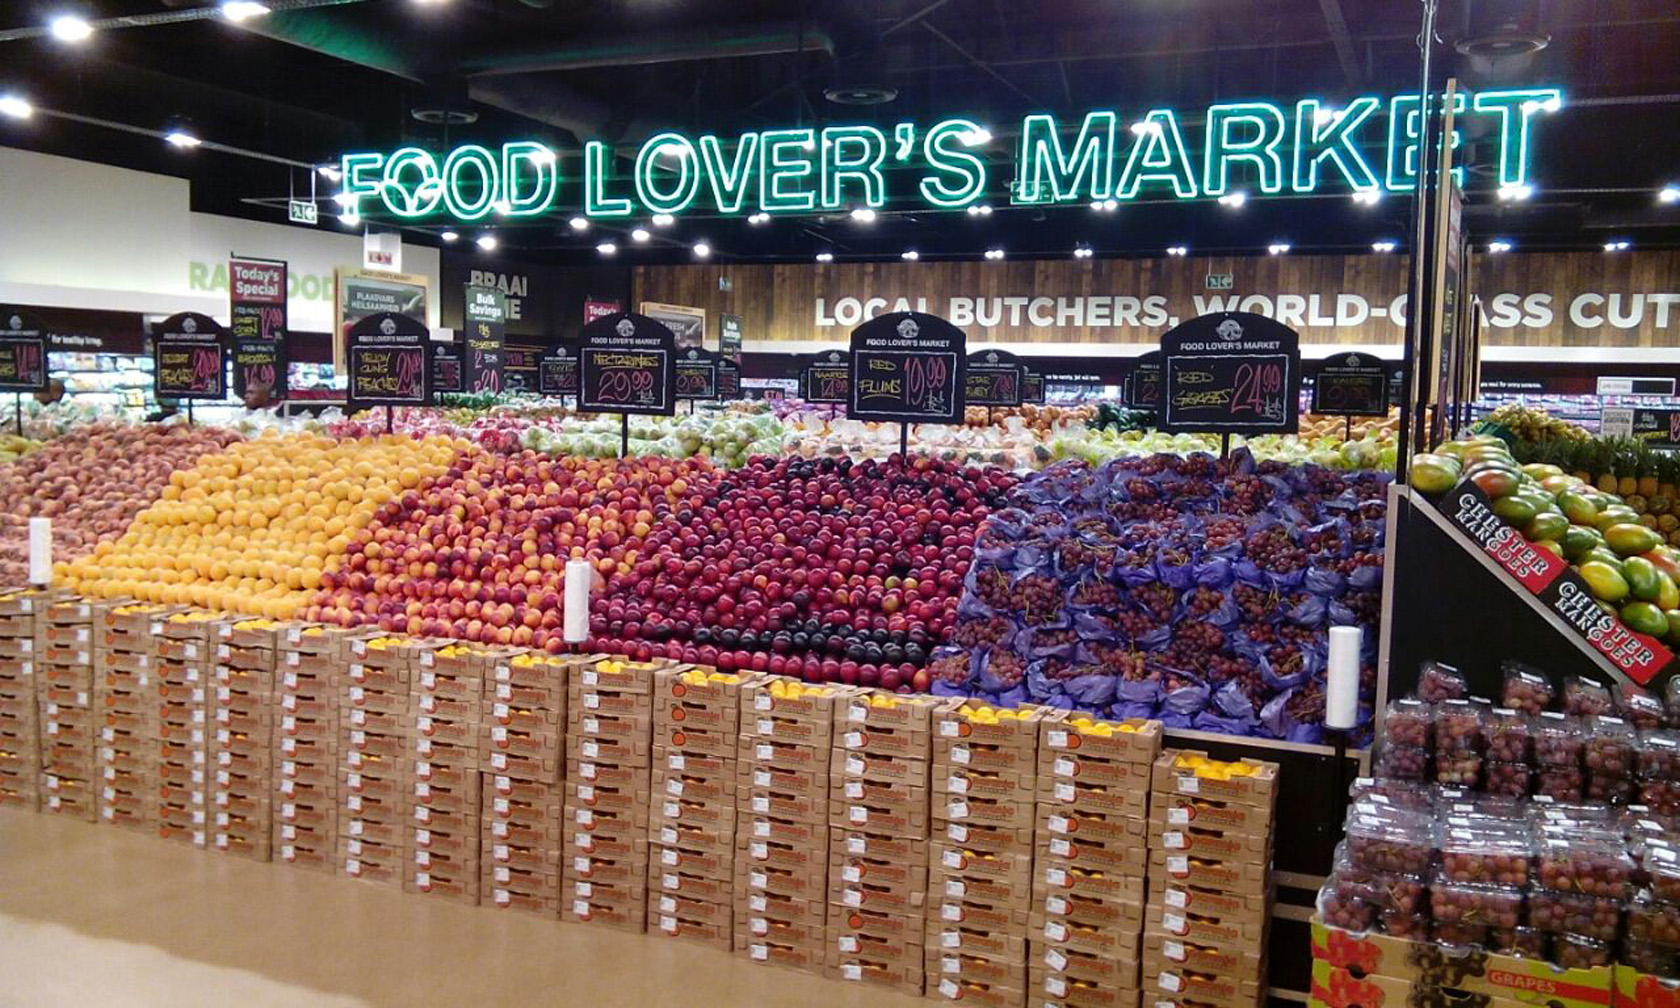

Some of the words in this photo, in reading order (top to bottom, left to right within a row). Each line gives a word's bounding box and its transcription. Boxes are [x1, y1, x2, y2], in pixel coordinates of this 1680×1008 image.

[340, 141, 557, 222] FOOD
[584, 119, 988, 215] LOVER'S
[1018, 88, 1562, 201] MARKET
[234, 266, 280, 282] Today's
[236, 281, 279, 296] Special
[476, 293, 496, 305] Bulk
[469, 303, 502, 318] Savings
[949, 296, 1180, 329] BUTCHERS,
[608, 337, 634, 345] LOVER'S
[866, 338, 886, 346] FOOD
[888, 338, 918, 347] LOVER'S
[919, 339, 950, 348] MARKET
[1180, 342, 1204, 351] FOOD
[1206, 341, 1242, 350] LOVER'S
[1243, 341, 1281, 349] MARKET
[869, 358, 897, 371] RED
[1177, 371, 1214, 384] RED
[1458, 492, 1549, 577] CHESTER
[1454, 509, 1530, 579] MANGOES
[1558, 581, 1654, 666] CHESTER
[1554, 597, 1635, 669] MANGOES
[1490, 971, 1557, 995] GRAPES
